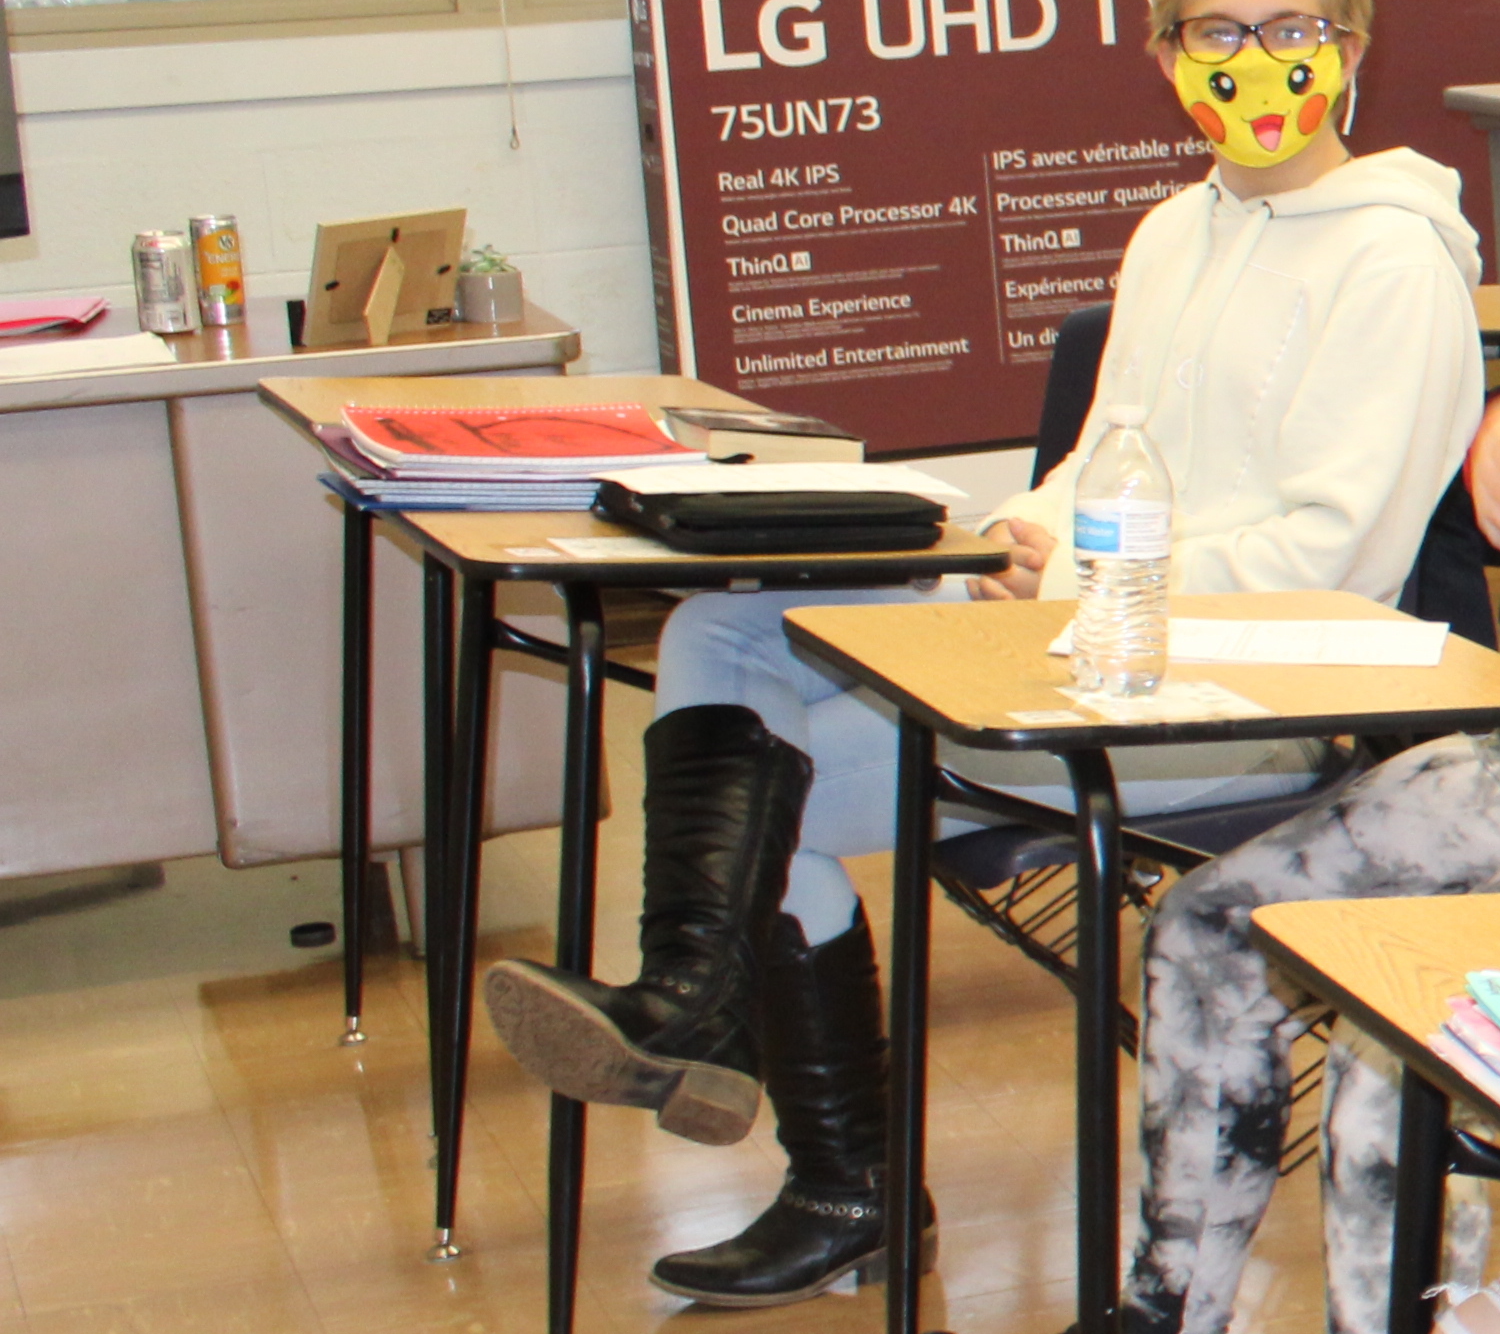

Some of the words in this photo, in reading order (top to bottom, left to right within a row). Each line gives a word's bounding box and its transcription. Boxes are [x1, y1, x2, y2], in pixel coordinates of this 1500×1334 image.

[711, 95, 882, 141] 75UN73
[993, 149, 1026, 170] IPS
[1032, 150, 1077, 167] avec
[1083, 140, 1169, 161] véritable
[718, 169, 764, 192] Real
[770, 168, 799, 187] 4K
[805, 163, 841, 185] IPS
[996, 188, 1108, 211] Processeur
[722, 212, 777, 237] Quad
[784, 209, 834, 229] Core
[840, 201, 943, 225] Processor
[948, 196, 978, 216] 4K
[1001, 231, 1060, 253] ThinQ
[726, 253, 790, 277] ThinQ
[1005, 272, 1104, 300] Expérience
[731, 302, 803, 323] Cinema
[809, 293, 912, 318] Experience
[1008, 331, 1034, 348] Un
[736, 349, 828, 375] Unlimited
[833, 337, 970, 365] Entertainment
